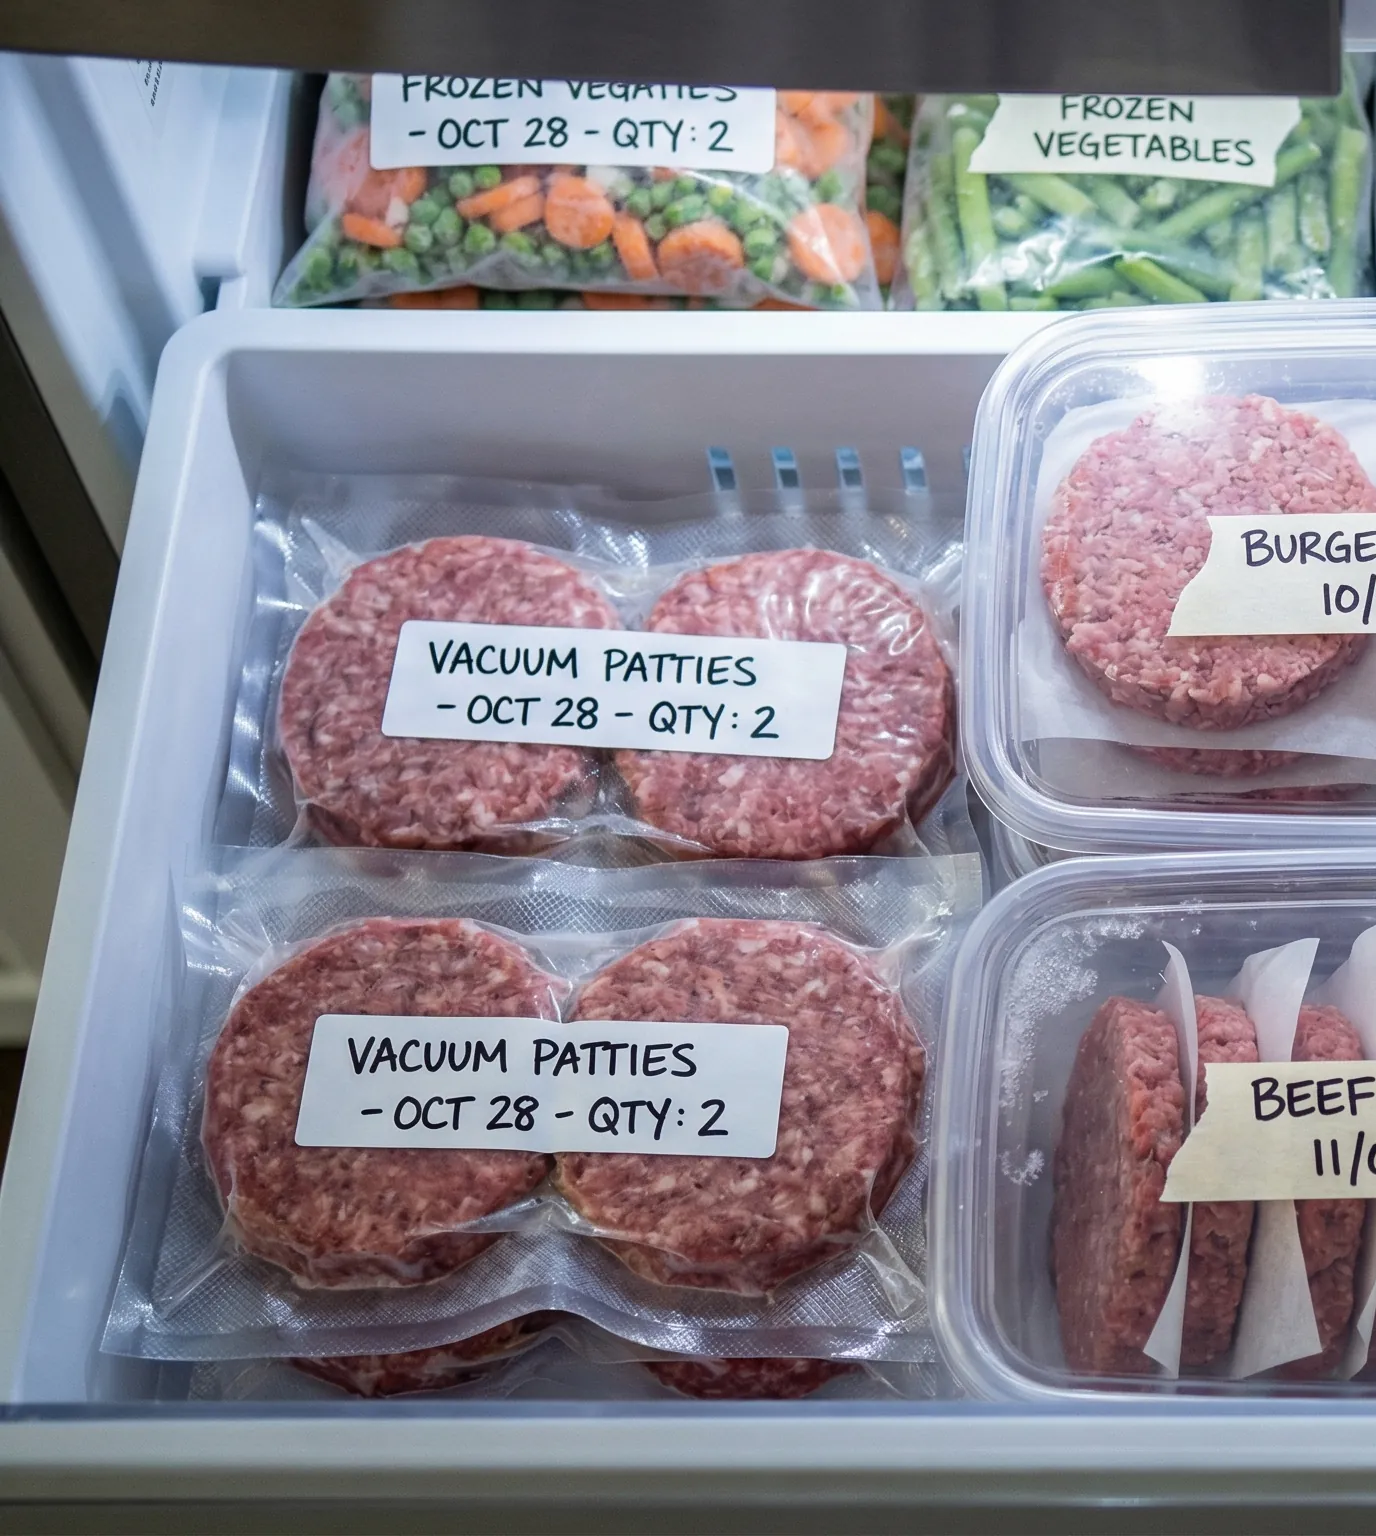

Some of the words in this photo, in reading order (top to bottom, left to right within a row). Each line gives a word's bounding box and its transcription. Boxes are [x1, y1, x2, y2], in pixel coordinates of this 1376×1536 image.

[402, 75, 543, 102] FROZEN
[1060, 95, 1194, 123] FROZEN
[437, 118, 510, 149] OCT
[523, 117, 569, 148] 28
[612, 117, 696, 152] QTY:
[708, 120, 734, 152] 2
[1033, 131, 1255, 167] VEGETABLES
[428, 639, 578, 679] VACUUM
[603, 648, 757, 687] PATTIES
[466, 694, 541, 726] OCT
[550, 696, 599, 730] 28
[648, 700, 739, 740] QTY:
[749, 705, 780, 739] 2
[347, 1035, 508, 1075] VACUUM
[532, 1038, 698, 1078] PATTIES
[393, 1095, 477, 1131] OCT
[485, 1095, 540, 1132] 28
[588, 1096, 686, 1141] QTY:
[697, 1098, 729, 1137] 2
[1250, 1076, 1376, 1121] BEEF
